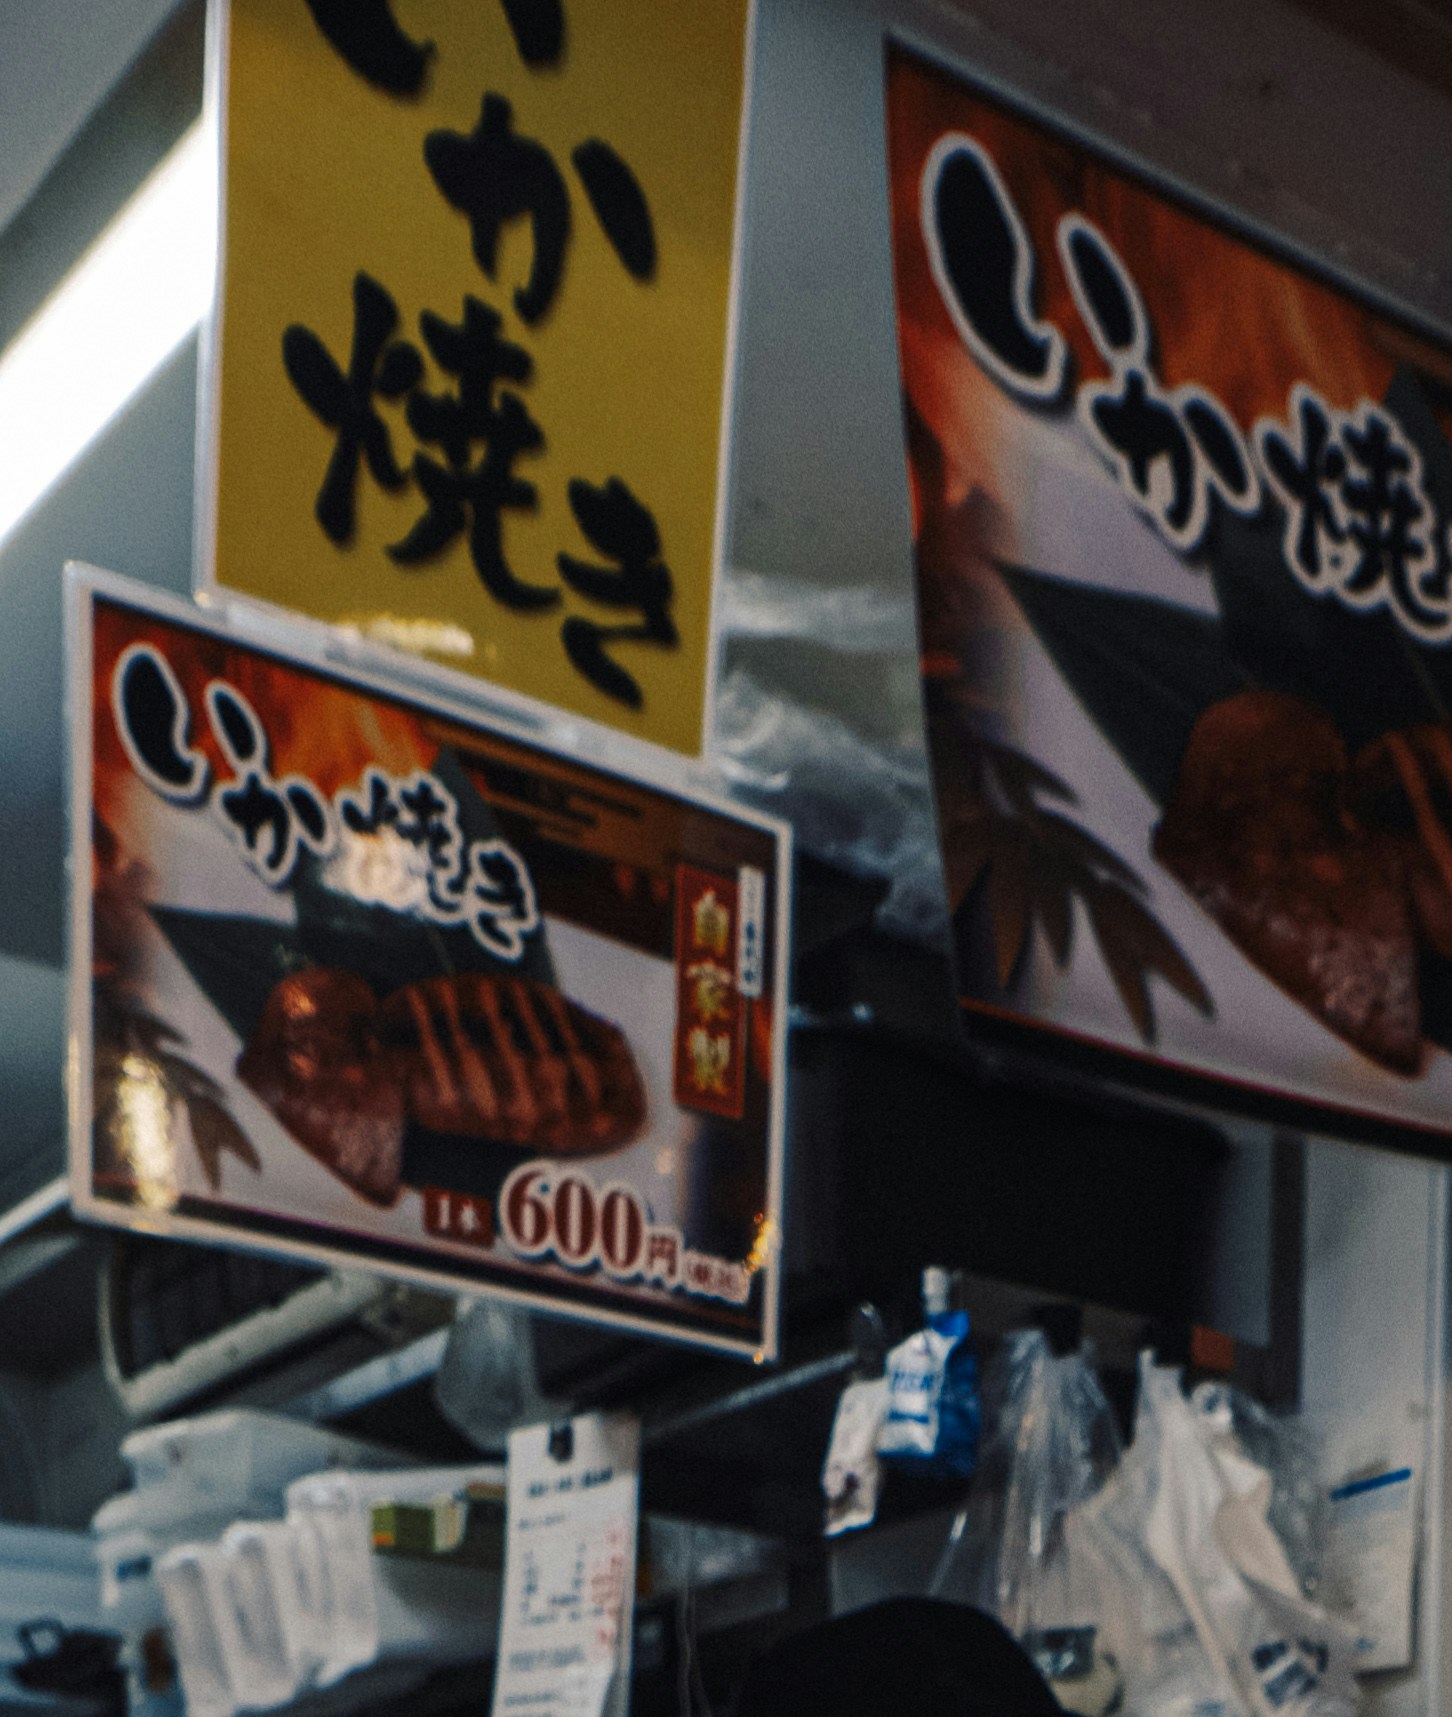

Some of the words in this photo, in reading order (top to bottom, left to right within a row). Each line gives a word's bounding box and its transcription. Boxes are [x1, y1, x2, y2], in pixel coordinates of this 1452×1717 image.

[112, 642, 537, 960] いか焼き
[683, 886, 733, 1097] 自家製
